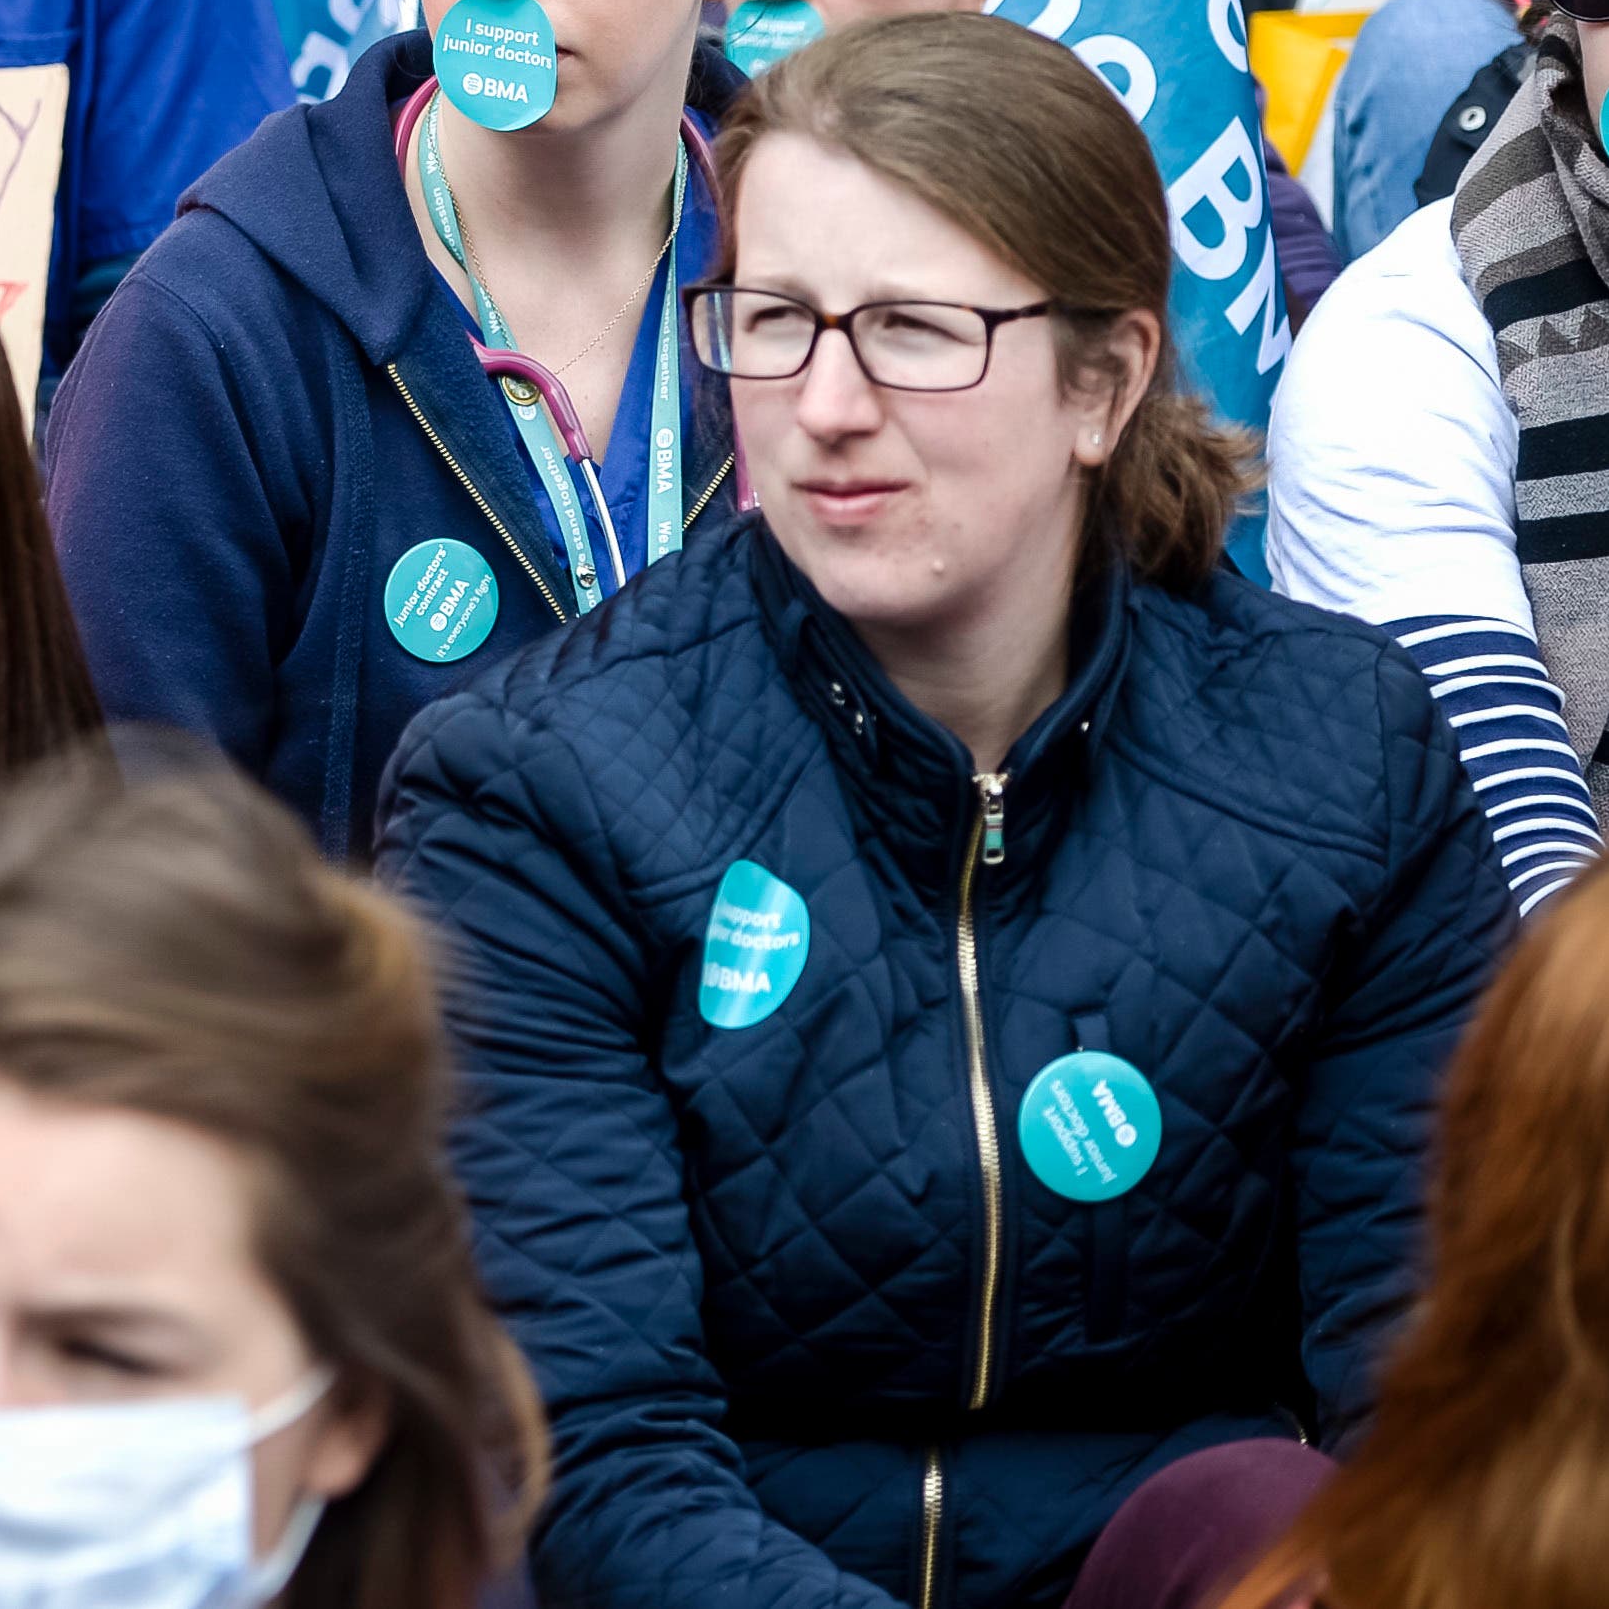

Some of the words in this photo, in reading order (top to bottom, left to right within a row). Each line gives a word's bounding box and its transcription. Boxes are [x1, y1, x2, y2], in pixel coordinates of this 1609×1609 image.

[442, 33, 493, 57] junior
[494, 44, 552, 70] doctors
[465, 18, 472, 33] I
[475, 22, 539, 47] support
[483, 76, 529, 104] BMA
[658, 336, 670, 401] together
[539, 444, 574, 509] together
[656, 449, 673, 495] BMA
[563, 507, 584, 551] stand
[658, 520, 672, 544] We
[393, 589, 421, 629] Junior
[416, 542, 448, 593] doctors'
[415, 568, 449, 617] contract
[439, 578, 471, 618] BMA
[446, 595, 481, 645] everyone's
[474, 573, 493, 597] fight
[718, 966, 772, 994] BMA
[1049, 1079, 1091, 1138] doctors
[1091, 1078, 1128, 1130] BMA
[1042, 1104, 1085, 1167] support
[1083, 1138, 1118, 1185] junior
